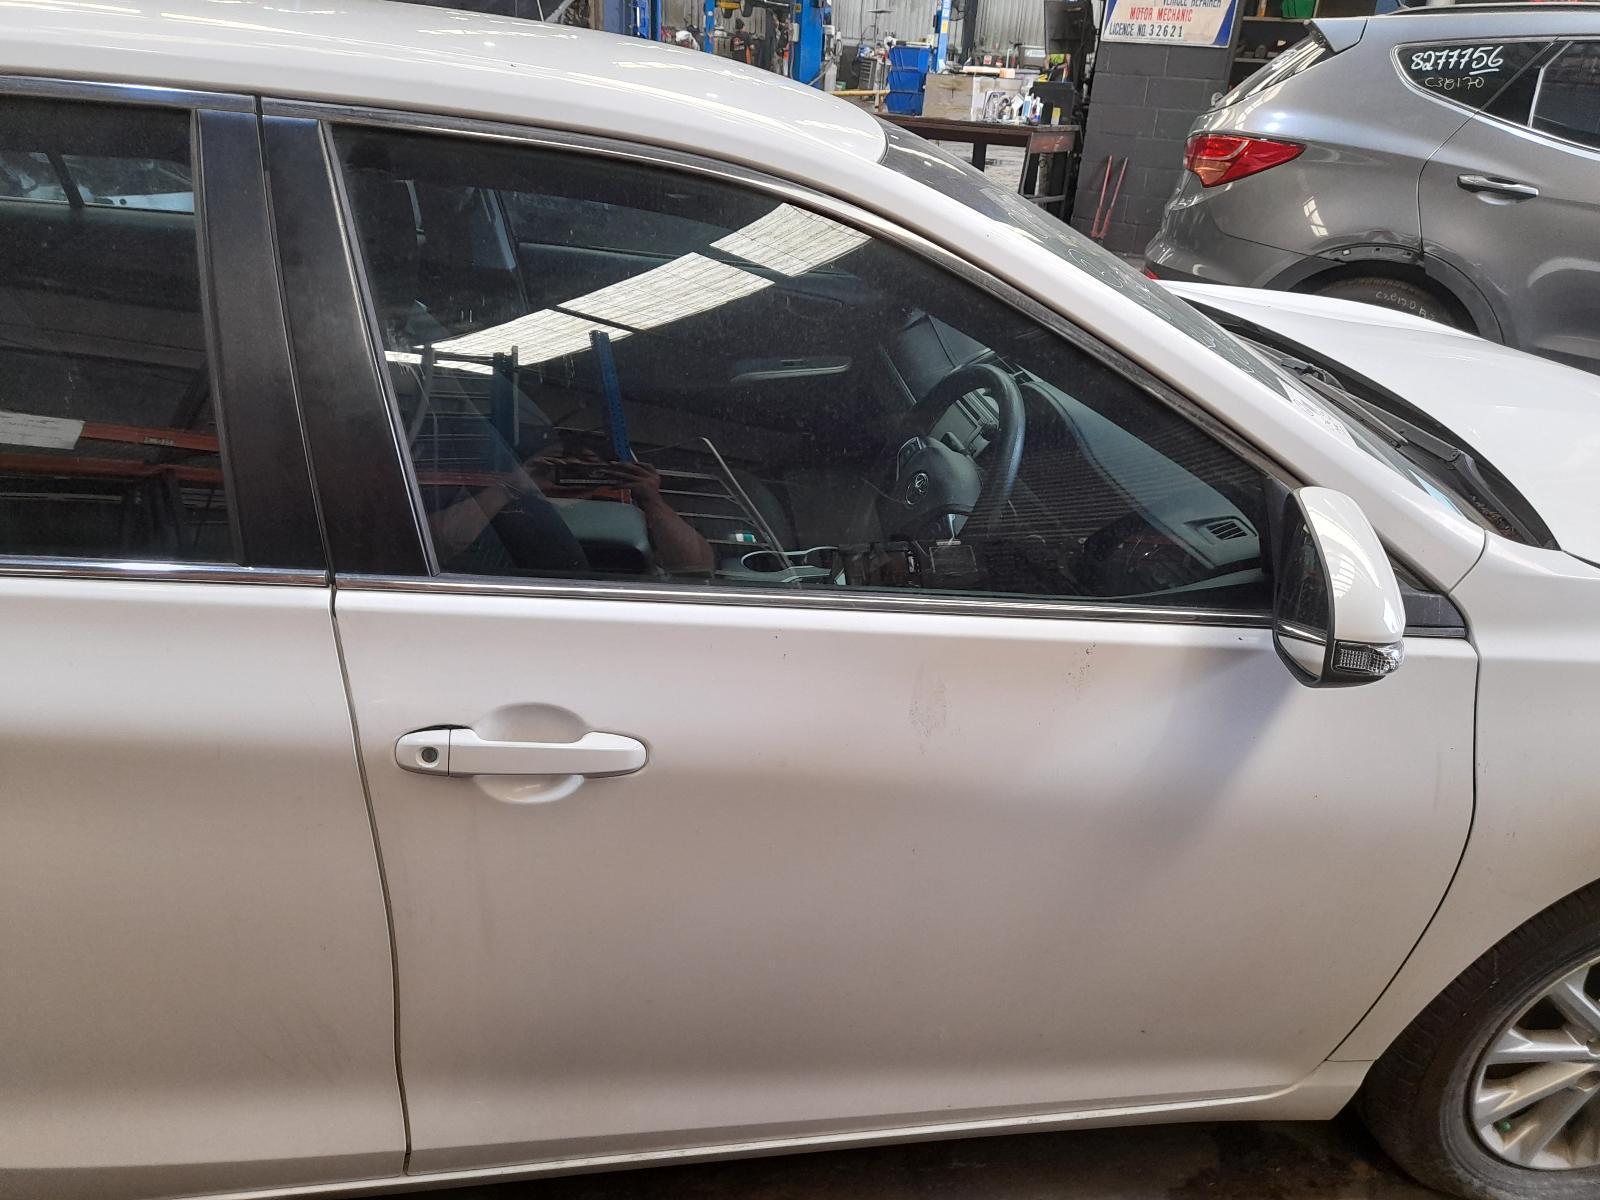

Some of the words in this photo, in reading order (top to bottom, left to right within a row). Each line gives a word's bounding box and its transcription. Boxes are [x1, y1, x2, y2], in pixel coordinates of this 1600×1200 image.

[1129, 7, 1153, 20] MOTOR
[1157, 8, 1193, 22] MECHANIC
[1109, 22, 1134, 37] LICENCE
[1148, 24, 1183, 38] 32621
[1411, 46, 1504, 71] 8277756
